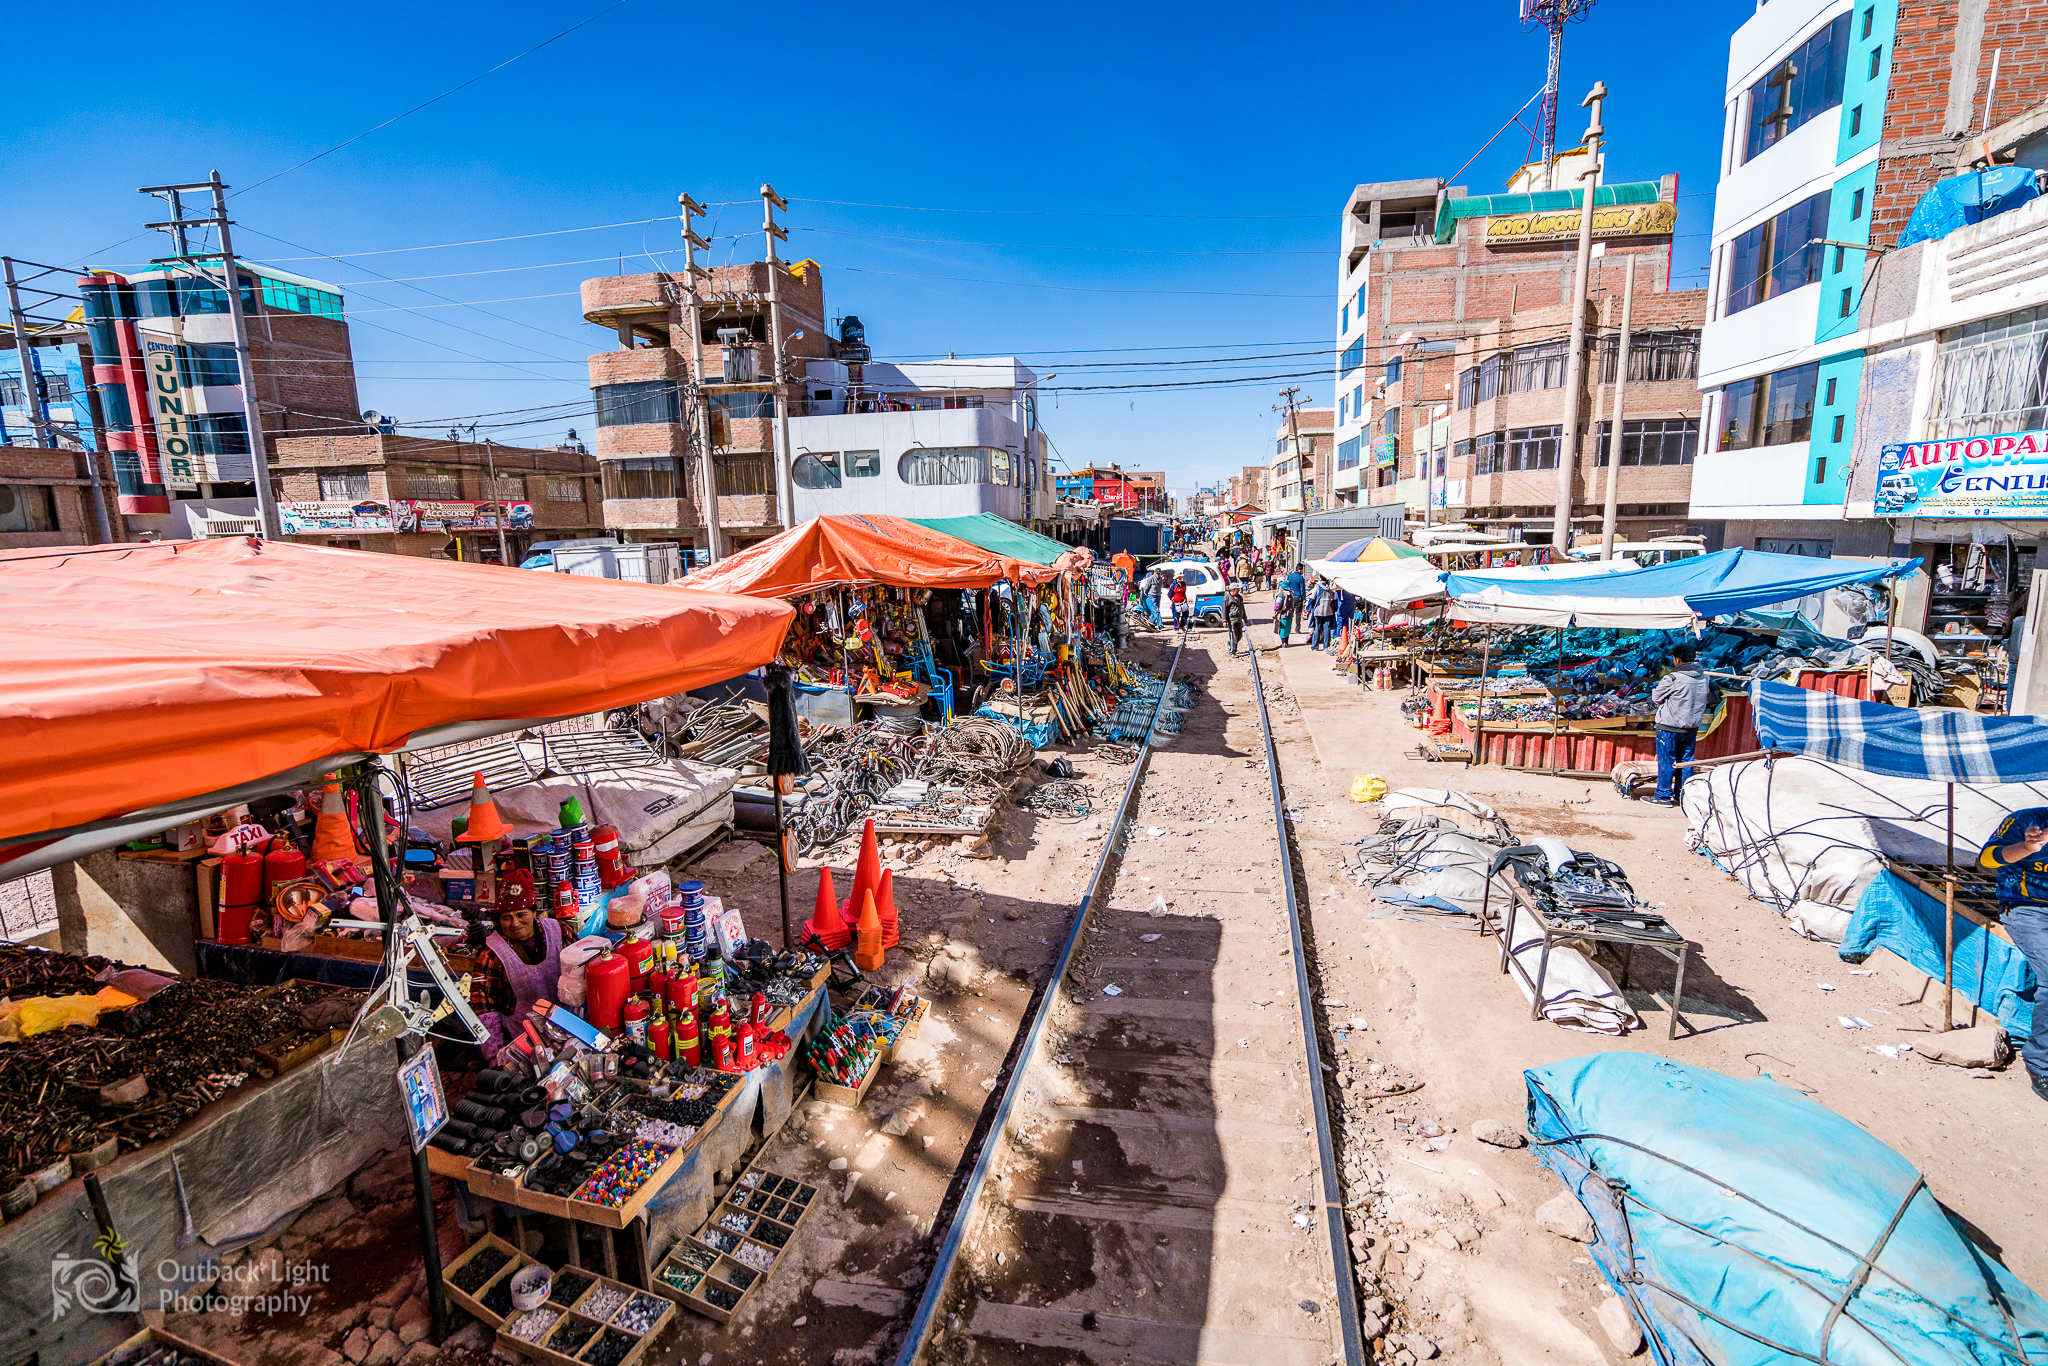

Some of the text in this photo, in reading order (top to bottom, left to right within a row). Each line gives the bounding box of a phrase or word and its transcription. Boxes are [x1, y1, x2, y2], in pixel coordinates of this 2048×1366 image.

[1487, 218, 1530, 236] MOTO
[147, 341, 174, 352] CENTRO
[155, 355, 193, 478] JUNIOR
[1936, 464, 2048, 494] GENIU
[292, 502, 318, 511] AUTO
[414, 500, 442, 510] AUTO
[300, 510, 350, 518] ACCESORIOS
[230, 826, 263, 846] TAXI
